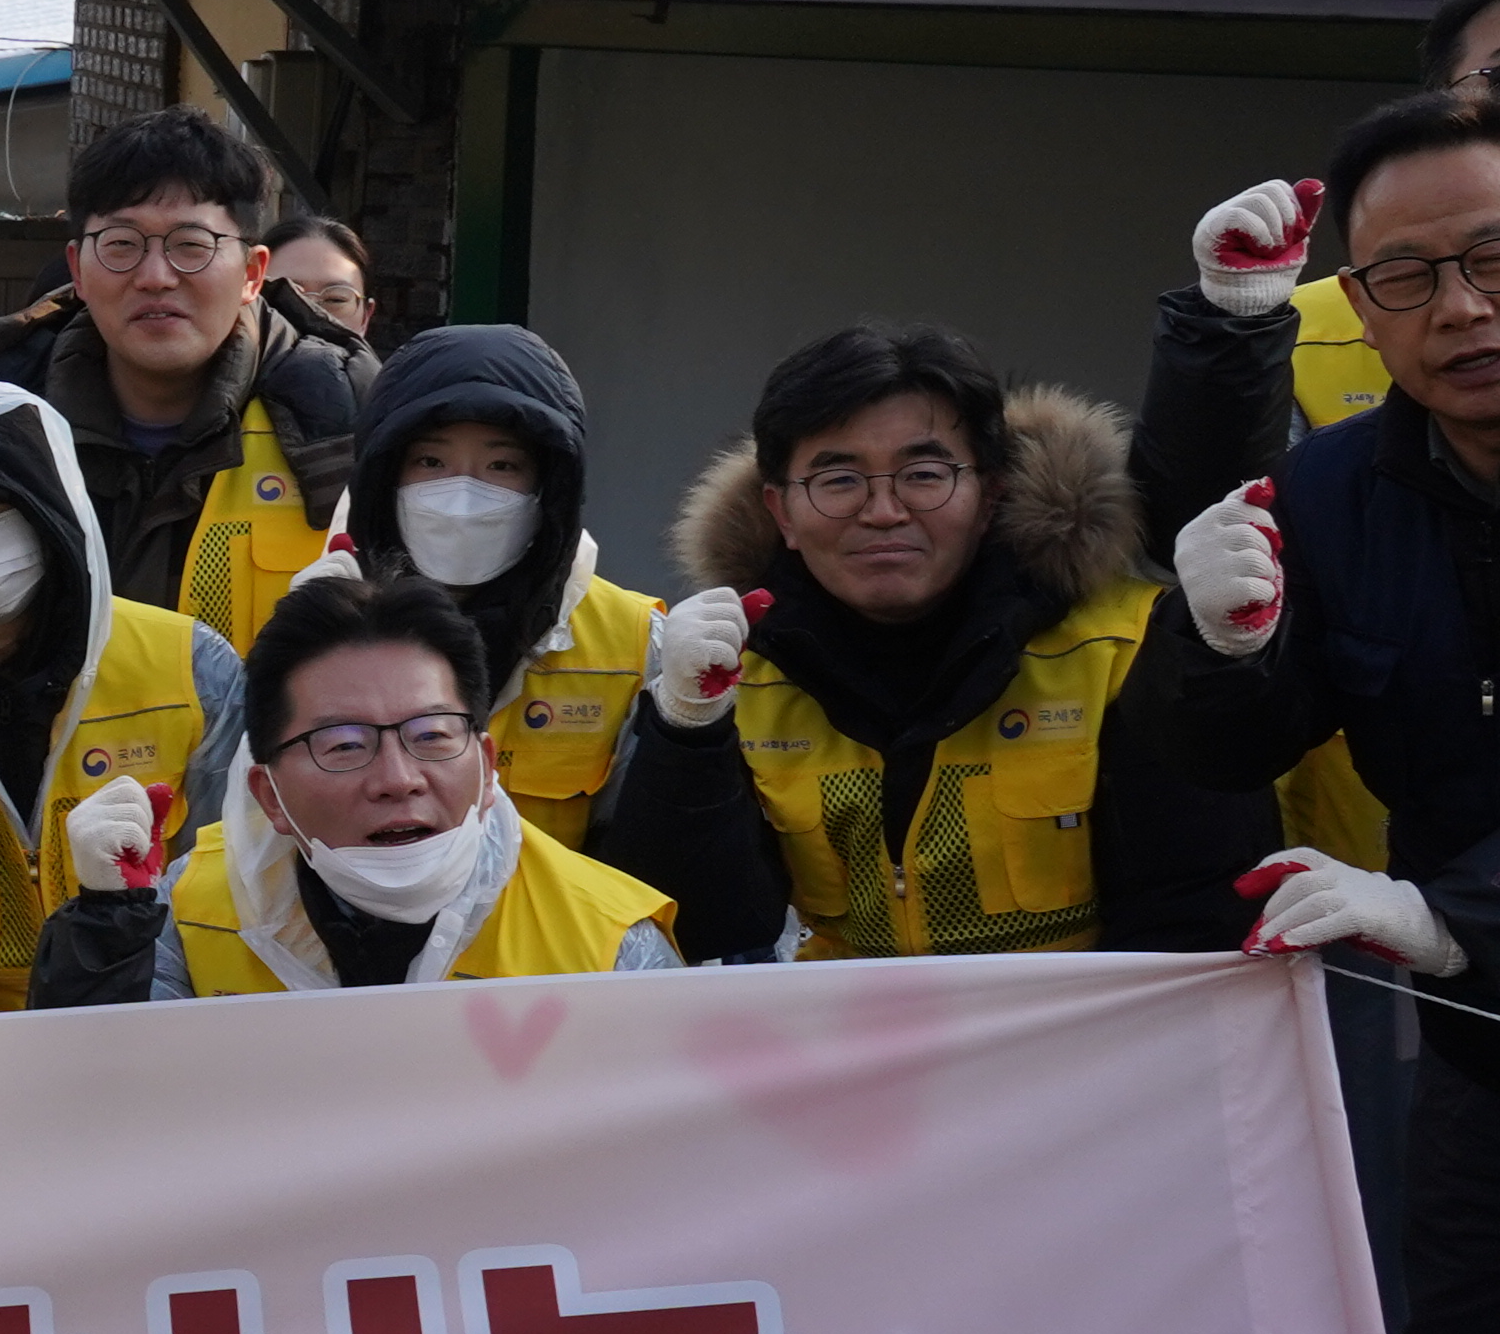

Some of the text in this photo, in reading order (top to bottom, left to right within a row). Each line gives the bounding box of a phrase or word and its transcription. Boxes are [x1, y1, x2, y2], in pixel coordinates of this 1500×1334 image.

[561, 704, 602, 718] 국세청
[1038, 707, 1084, 723] 국세청
[118, 745, 156, 761] 국세청
